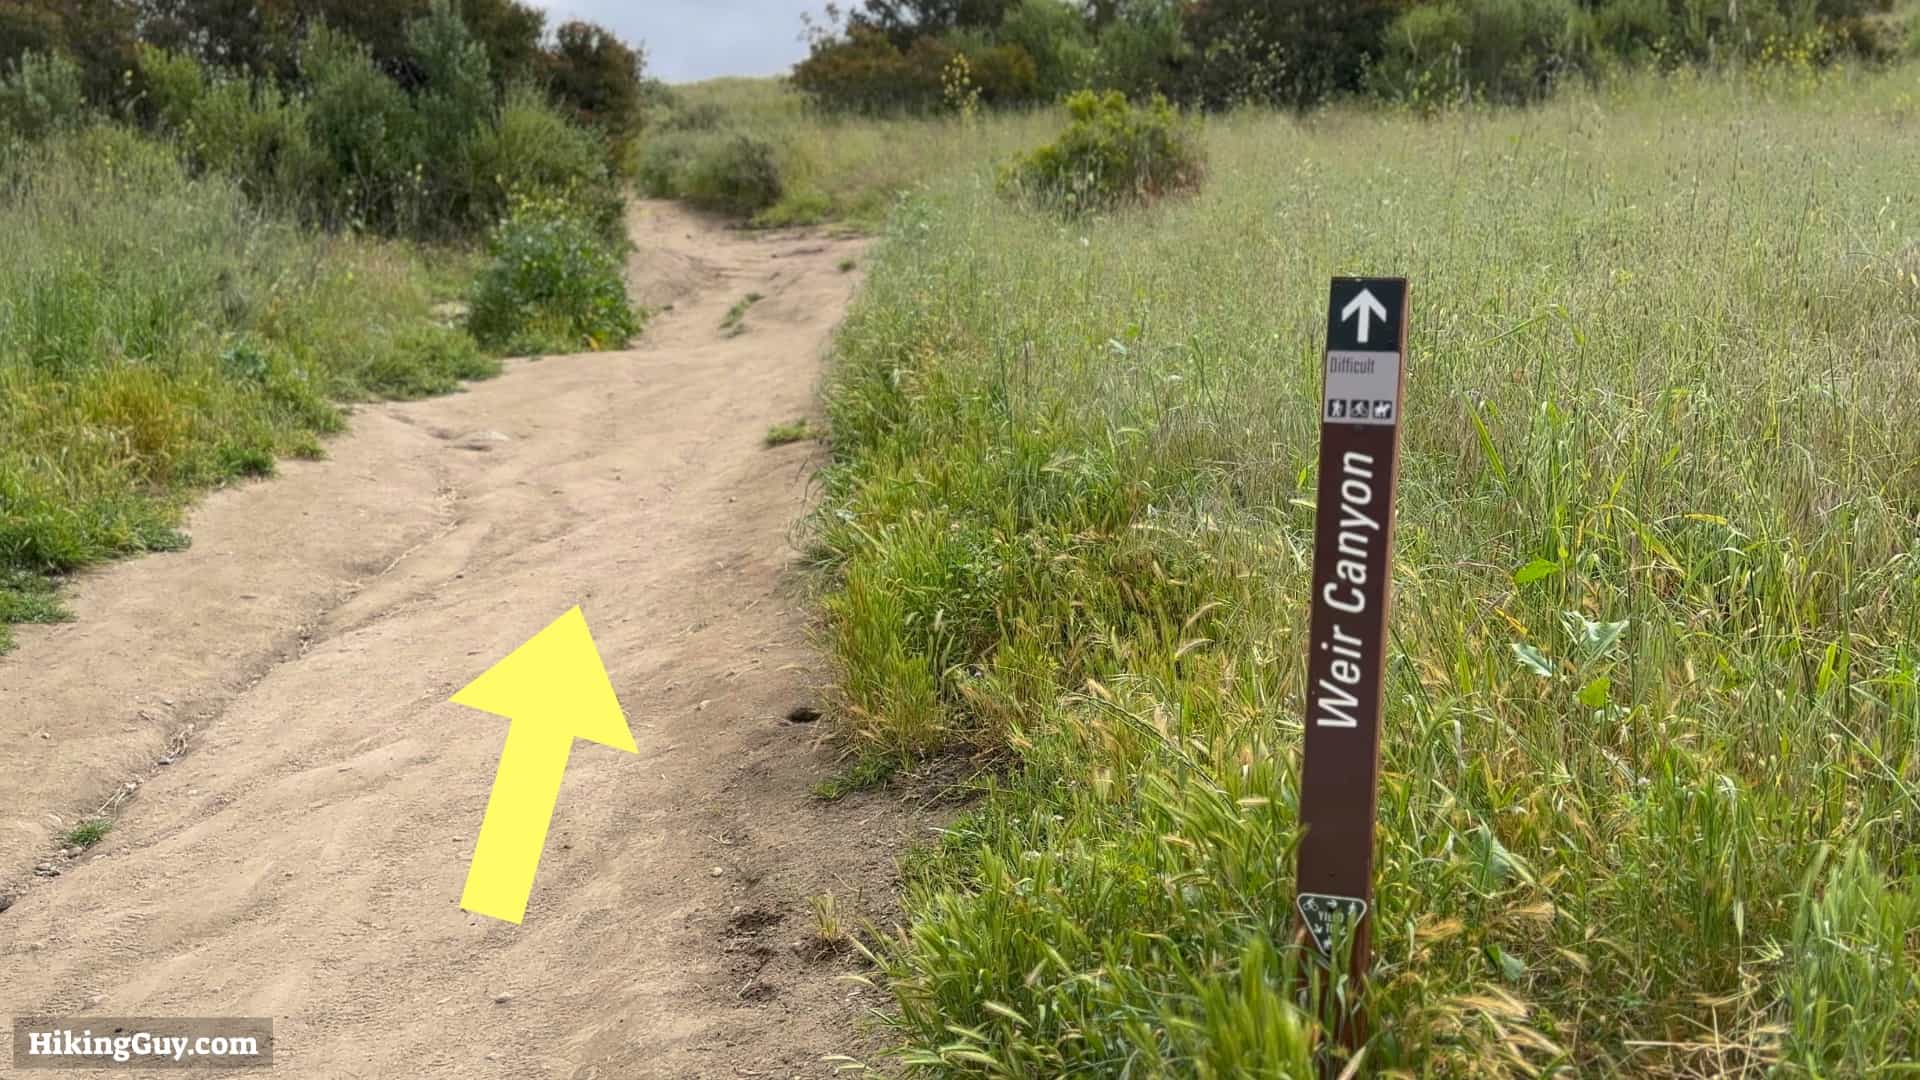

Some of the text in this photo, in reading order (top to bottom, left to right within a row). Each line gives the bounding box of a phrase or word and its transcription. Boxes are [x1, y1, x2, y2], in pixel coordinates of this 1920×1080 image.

[1330, 357, 1375, 374] Difficult
[1317, 451, 1379, 728] Weir Canyon
